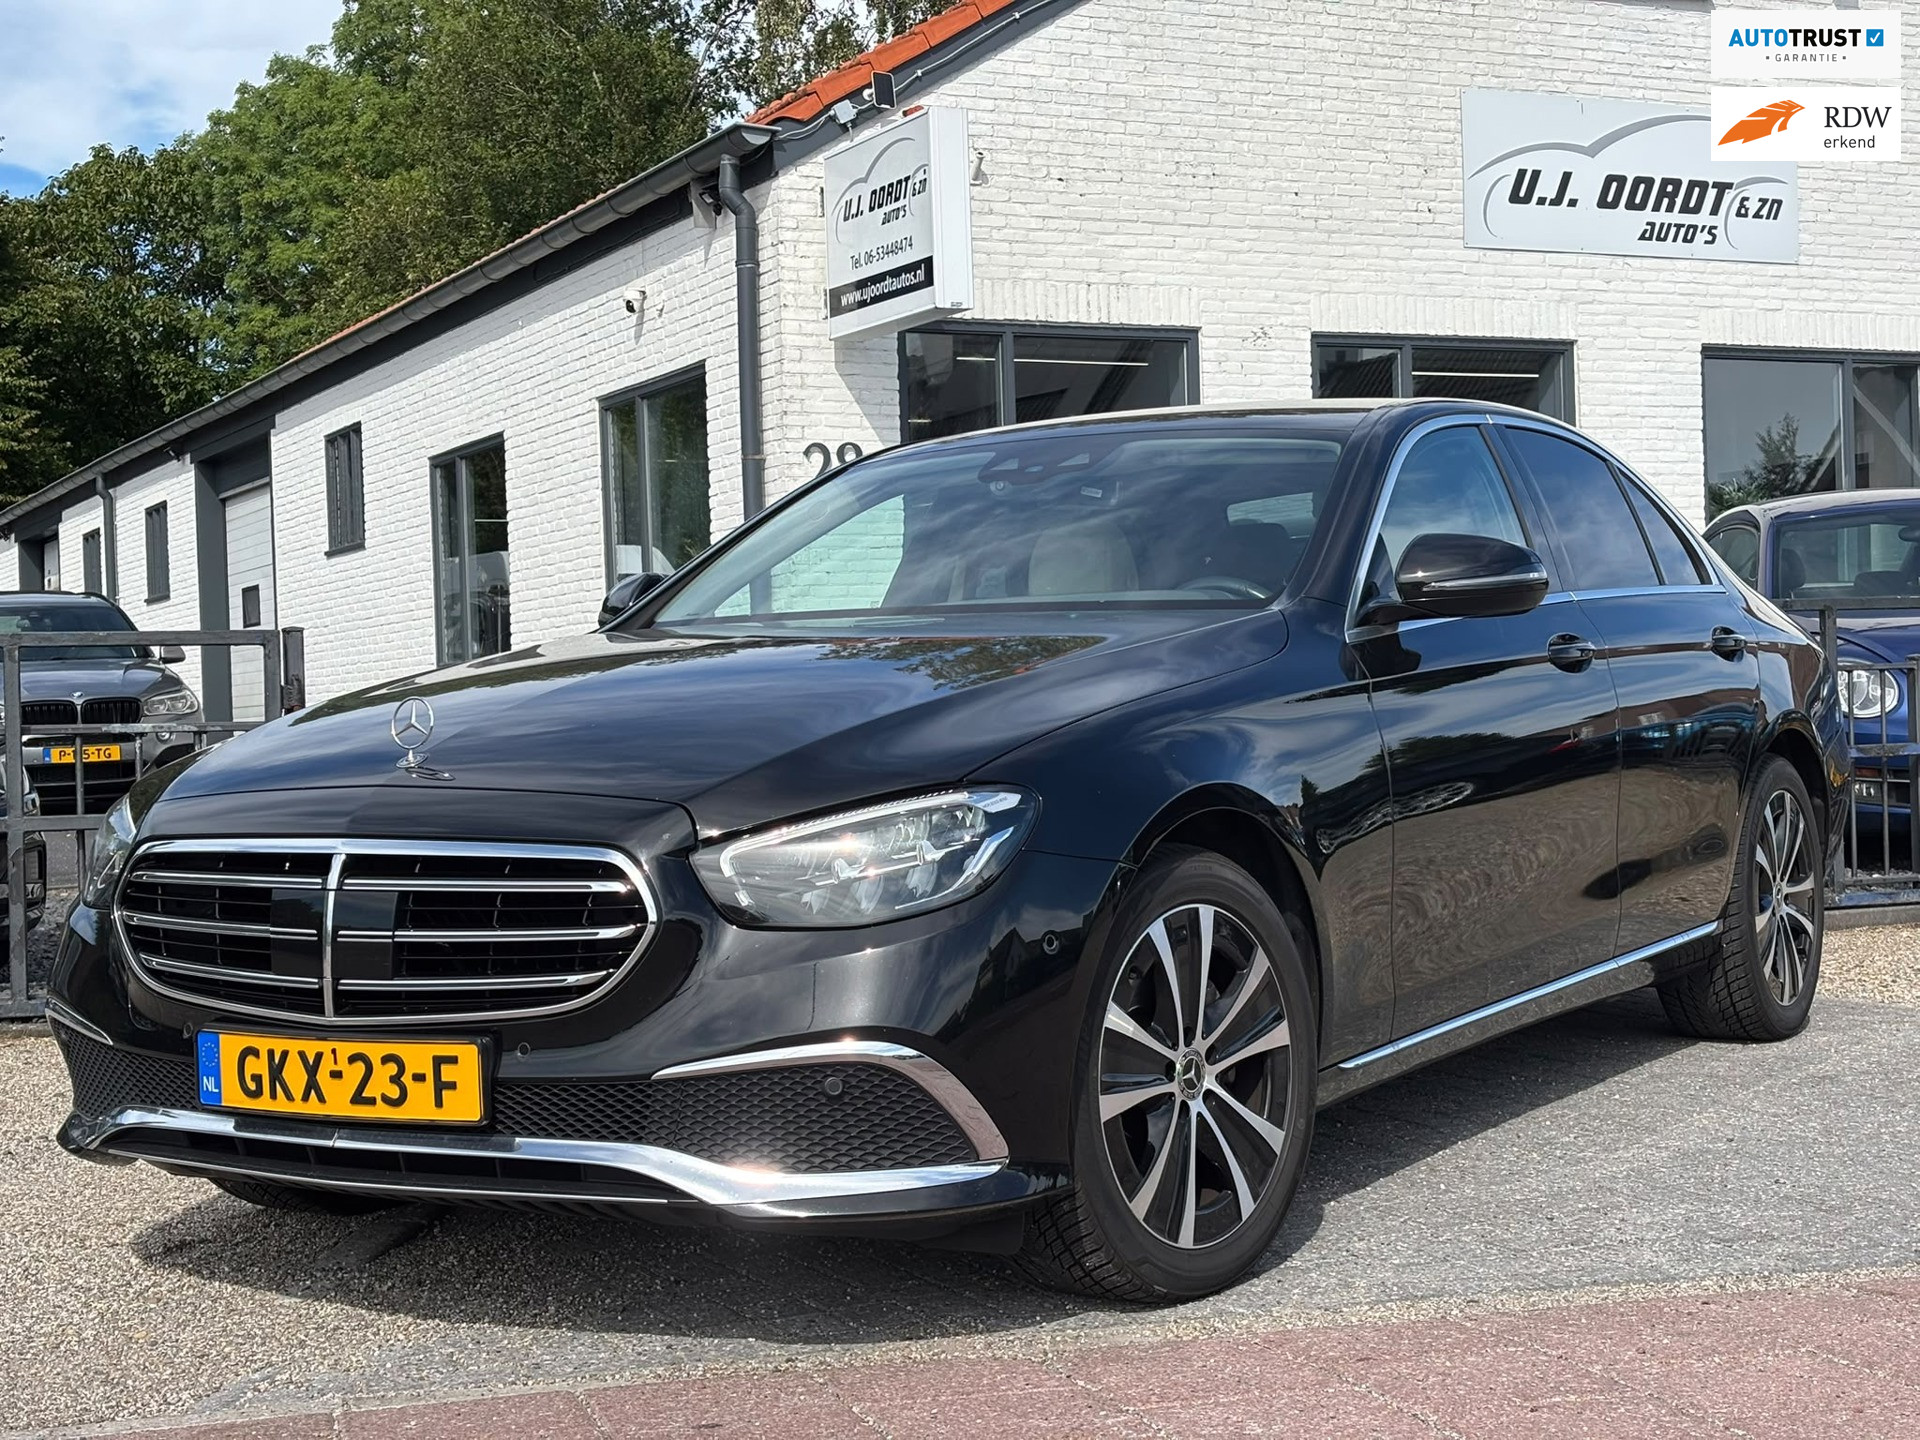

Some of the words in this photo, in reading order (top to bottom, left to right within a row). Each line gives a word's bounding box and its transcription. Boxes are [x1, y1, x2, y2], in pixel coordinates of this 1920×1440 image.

[843, 194, 864, 222] U.J.
[868, 174, 911, 213] OORDT
[1508, 168, 1579, 208] U.J.
[1596, 173, 1735, 217] OORDT
[881, 204, 907, 226] AUTO'S
[1637, 221, 1718, 245] AUTO'S
[850, 252, 863, 270] Tel.
[863, 235, 913, 266] 06-53448474
[840, 263, 925, 307] www.ujoordtautos.nl
[203, 1076, 219, 1093] NL
